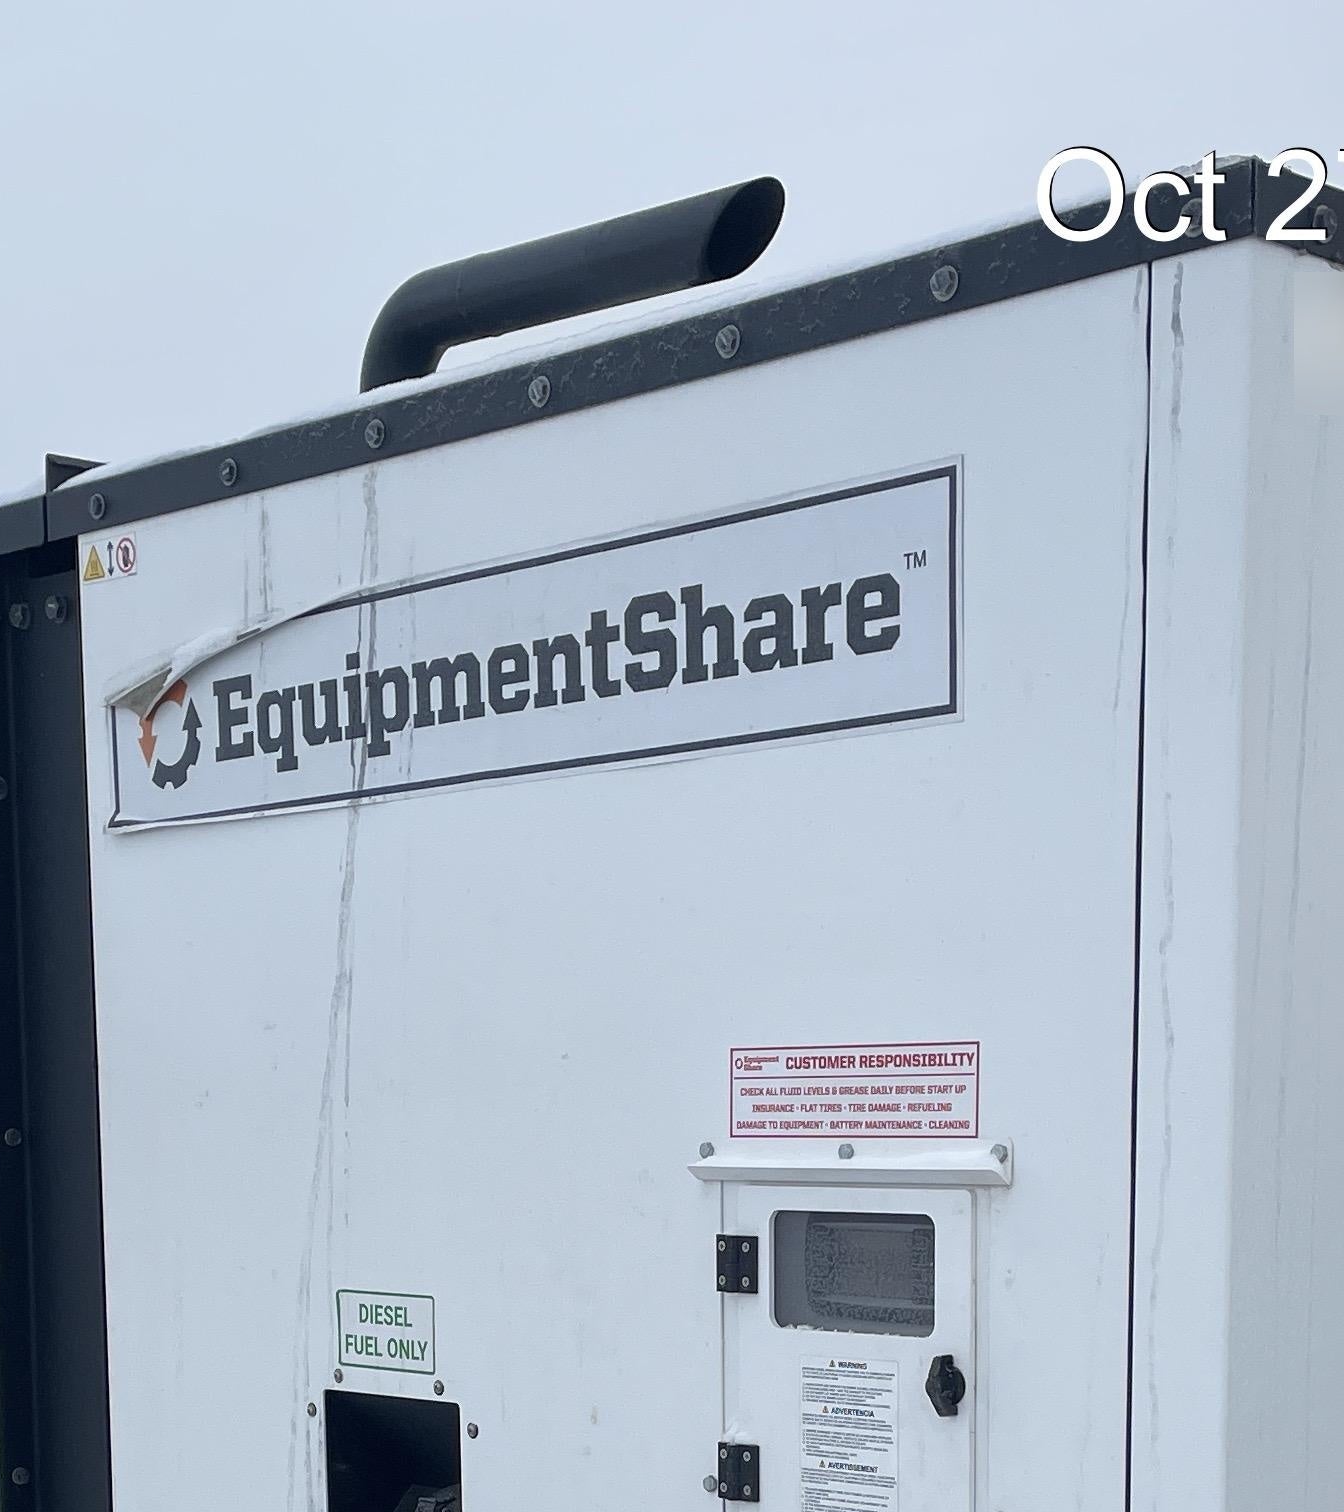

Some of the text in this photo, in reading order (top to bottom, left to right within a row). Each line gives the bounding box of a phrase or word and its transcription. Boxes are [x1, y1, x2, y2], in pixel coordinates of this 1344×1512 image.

[213, 572, 901, 773] EquipmentShare
[785, 1052, 975, 1070] CUSTOMER RESPONSIBILITY
[740, 1087, 764, 1096] CHECK
[766, 1087, 778, 1096] ALL
[780, 1087, 802, 1096] FLUID
[804, 1086, 830, 1096] LEVELS
[839, 1086, 869, 1095] GREASE
[870, 1086, 894, 1094] DAILY
[896, 1085, 926, 1094] BEFORE
[928, 1085, 954, 1094] START
[955, 1084, 966, 1094] UP
[752, 1102, 952, 1112] INSURANCE FLAT TIRES TIRE DAMAGE REFUELING
[736, 1120, 970, 1130] DAMAGE TO EQUIPMENT BATTERY MAINTENANCE CLEANING
[358, 1303, 412, 1328] DIESEL
[345, 1334, 428, 1361] FUEL ONLY
[838, 1361, 868, 1370] WARNING
[830, 1408, 875, 1418] ADVERTENCIA
[828, 1461, 878, 1474] AVERTISSEMENT
